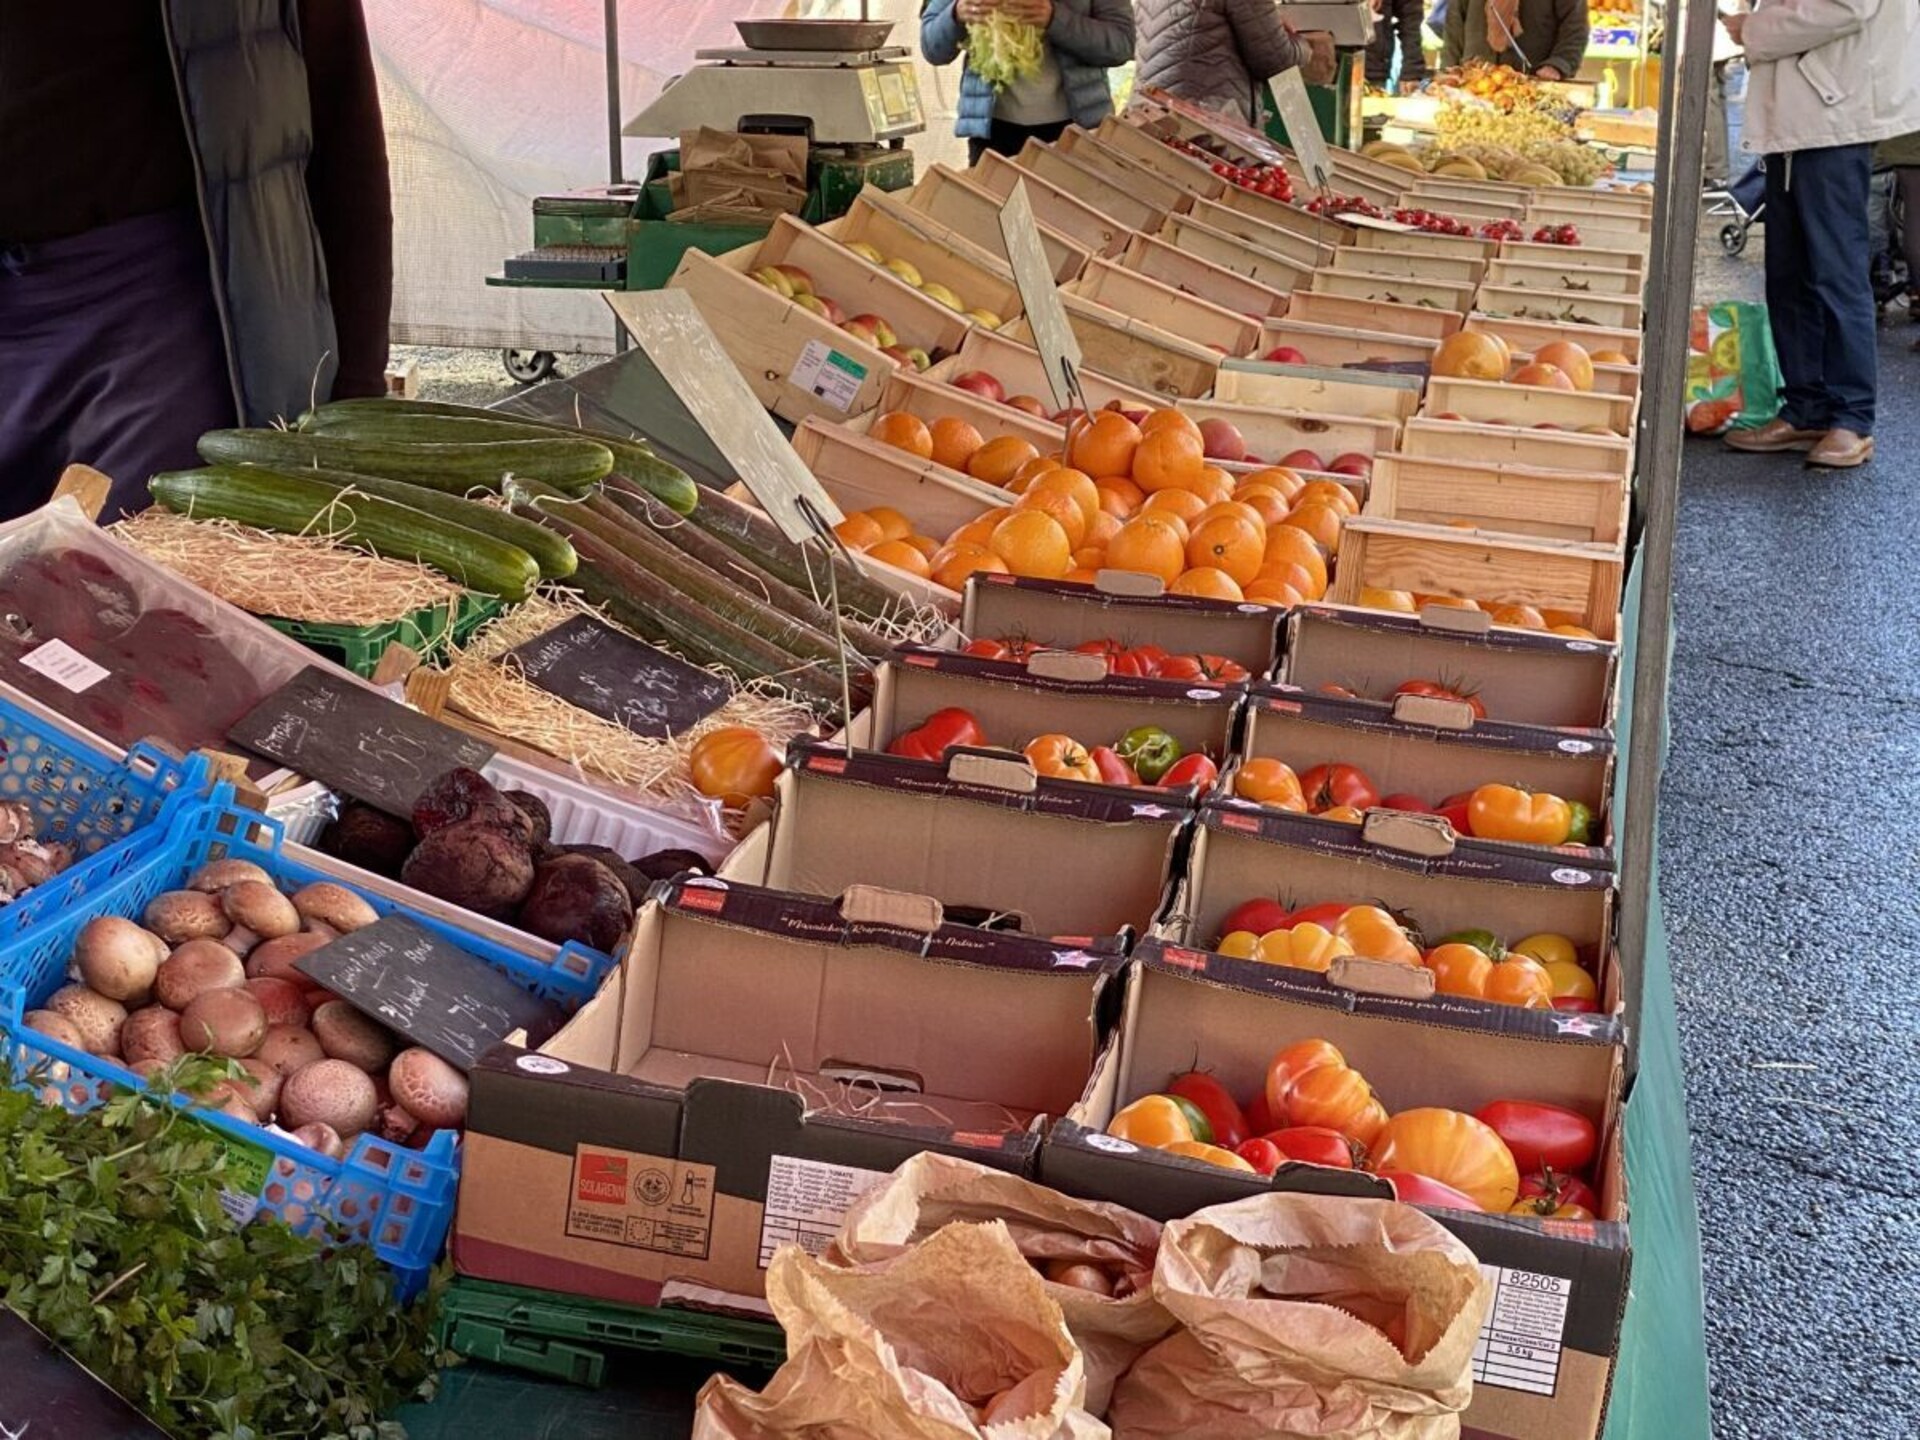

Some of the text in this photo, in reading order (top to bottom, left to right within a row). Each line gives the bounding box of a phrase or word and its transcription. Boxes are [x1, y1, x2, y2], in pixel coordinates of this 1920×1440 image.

[580, 1179, 625, 1199] SOLARENN
[1510, 1271, 1561, 1292] 82505
[1522, 1349, 1534, 1358] kg
